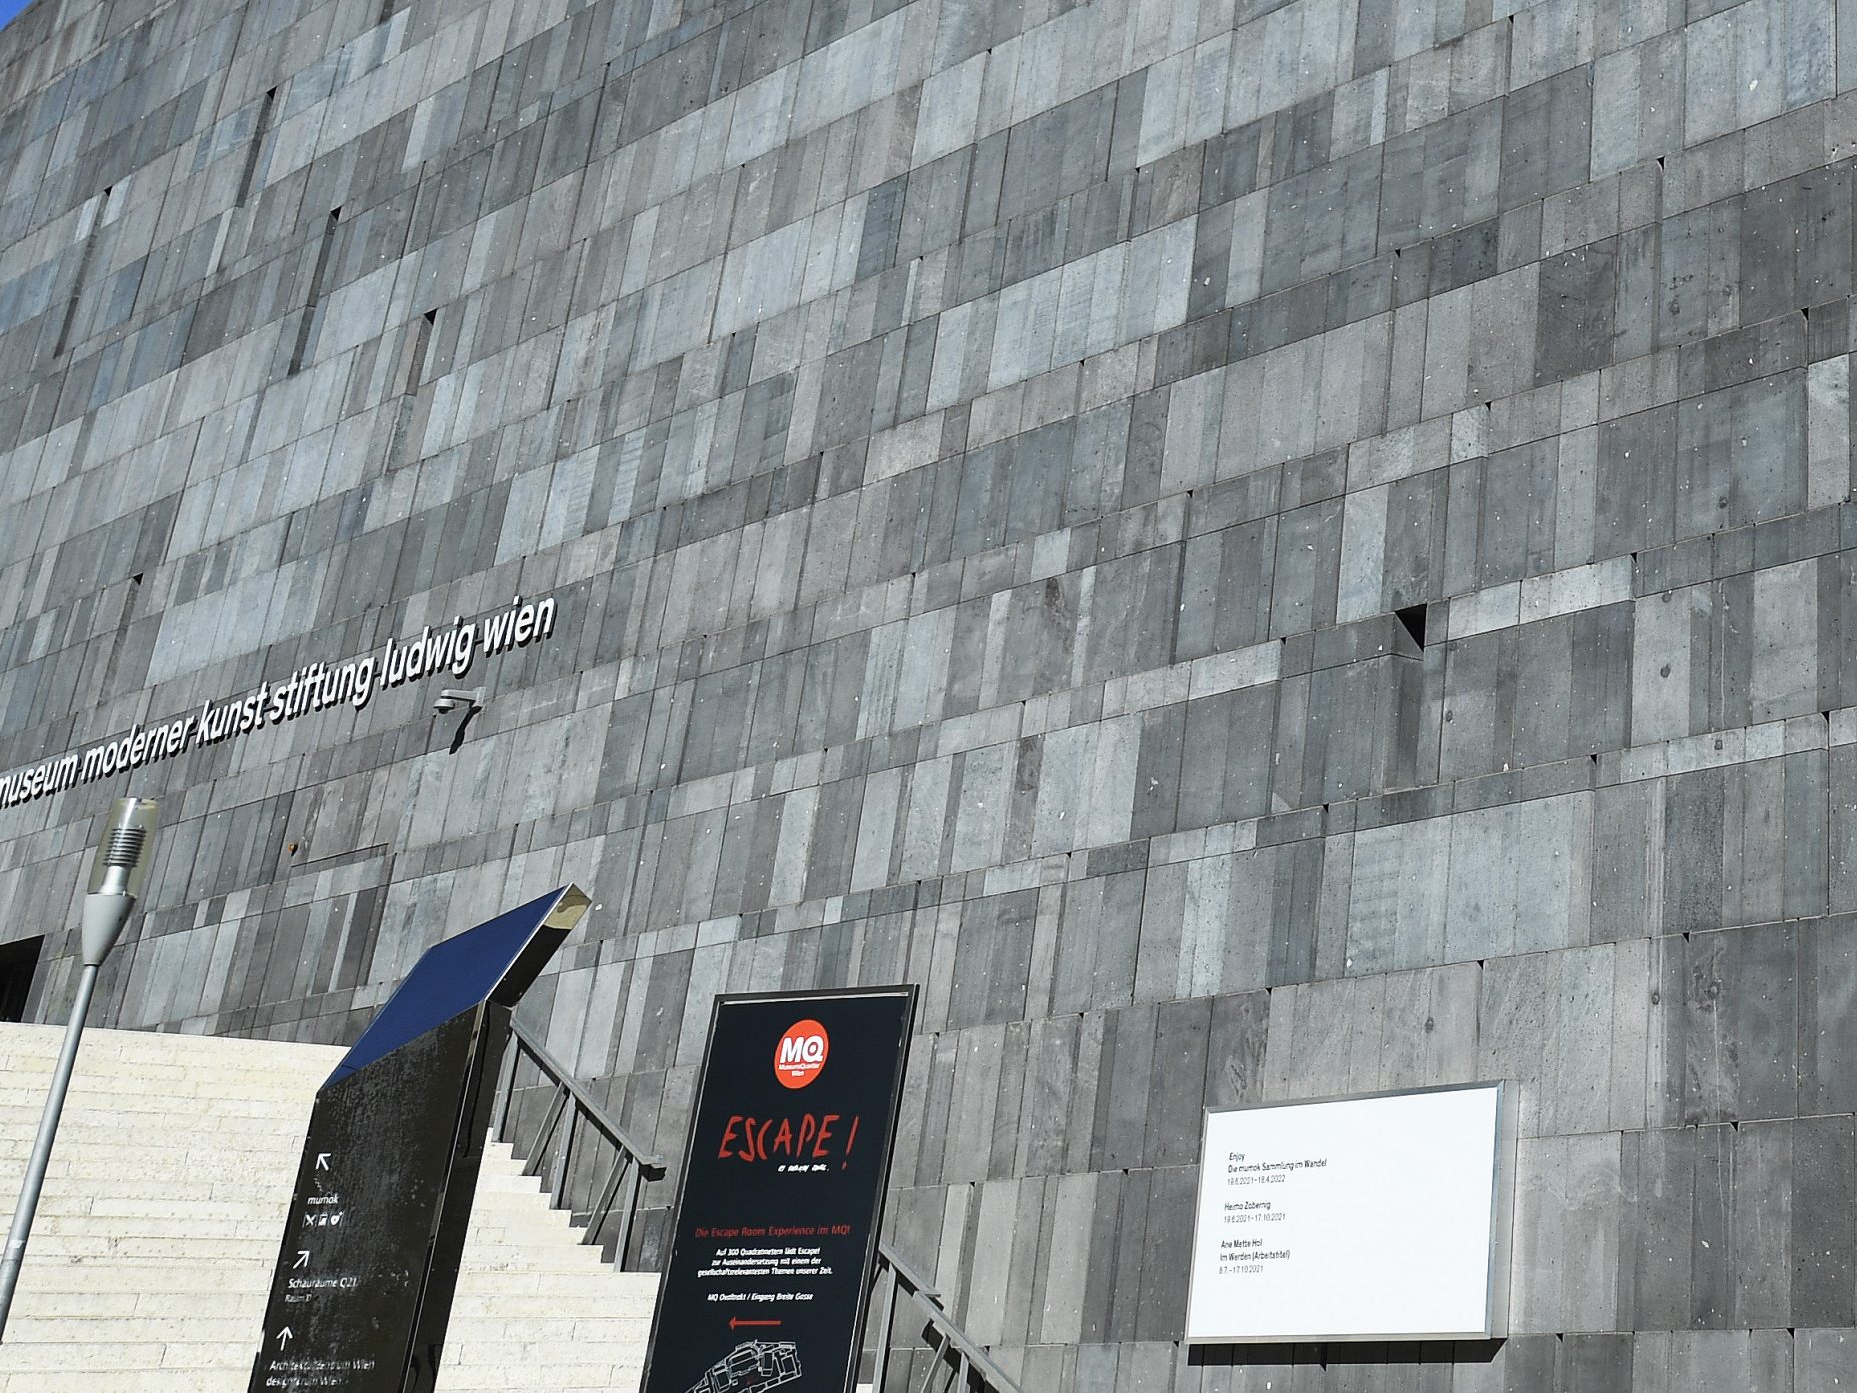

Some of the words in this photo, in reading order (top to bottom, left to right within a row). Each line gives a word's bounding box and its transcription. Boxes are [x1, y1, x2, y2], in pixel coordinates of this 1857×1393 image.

[81, 723, 197, 780] moderner
[195, 680, 268, 744] kunst
[270, 656, 376, 720] stiftung
[380, 616, 476, 687] ludwig
[484, 595, 555, 653] wien
[779, 1035, 824, 1064] MQ
[1229, 1152, 1245, 1162] Enjoy
[1228, 1164, 1238, 1173] Die
[1238, 1163, 1261, 1172] mumok
[1262, 1162, 1294, 1171] Sammlung
[1304, 1158, 1328, 1168] Wandel
[307, 1194, 339, 1205] mumok
[695, 1228, 708, 1238] Die
[711, 1227, 739, 1238] Escape
[741, 1227, 766, 1236] Room
[768, 1225, 815, 1237] Experience
[817, 1225, 829, 1235] im
[716, 1248, 727, 1256] Auf
[740, 1247, 783, 1256] Quadratmetern
[1229, 1252, 1251, 1261] Werden
[722, 1258, 778, 1266] Auseinandersetzung
[810, 1257, 822, 1265] der
[771, 1267, 794, 1275] Themen
[795, 1267, 819, 1275] unserer
[340, 1277, 358, 1289] Q21
[707, 1293, 718, 1301] MQ
[751, 1293, 775, 1302] Eingang
[776, 1293, 794, 1301] Breite
[795, 1292, 814, 1301] Gasse
[353, 1359, 375, 1370] Wien
